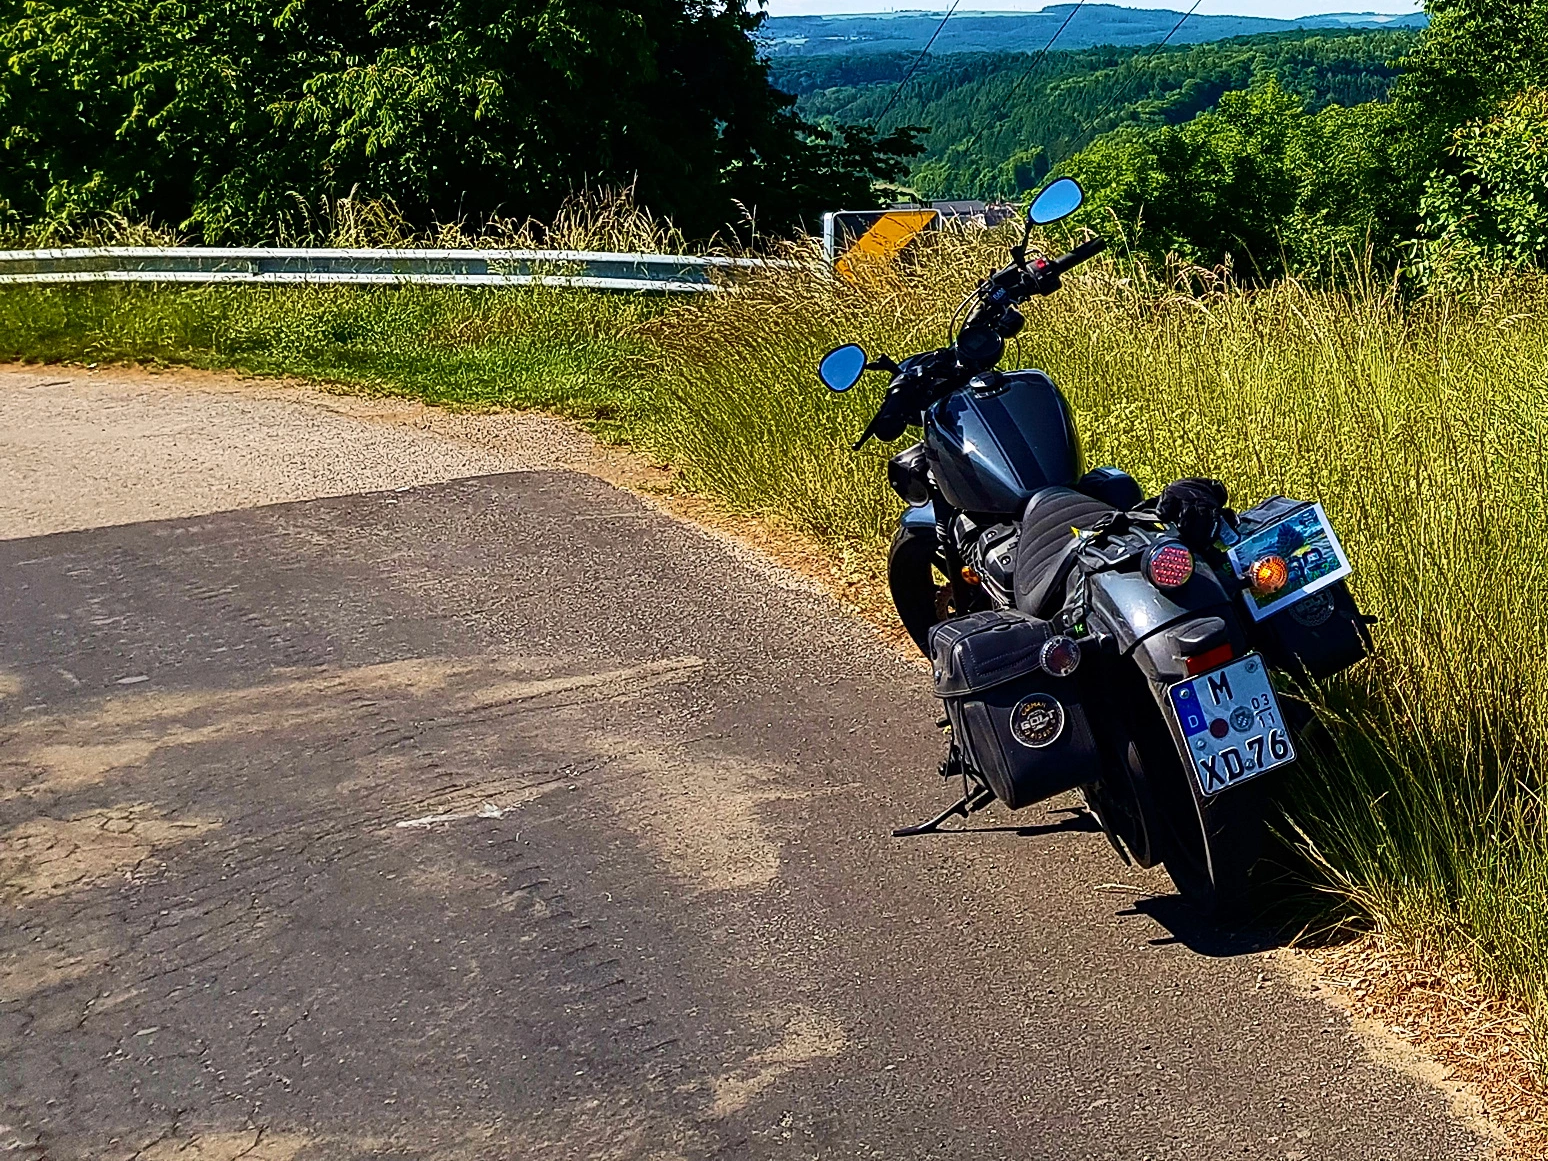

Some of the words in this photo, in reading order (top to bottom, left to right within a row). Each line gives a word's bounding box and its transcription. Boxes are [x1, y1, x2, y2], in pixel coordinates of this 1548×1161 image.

[1207, 671, 1234, 706] M
[1251, 693, 1270, 710] 03
[1187, 714, 1199, 728] D
[1257, 712, 1275, 728] 11
